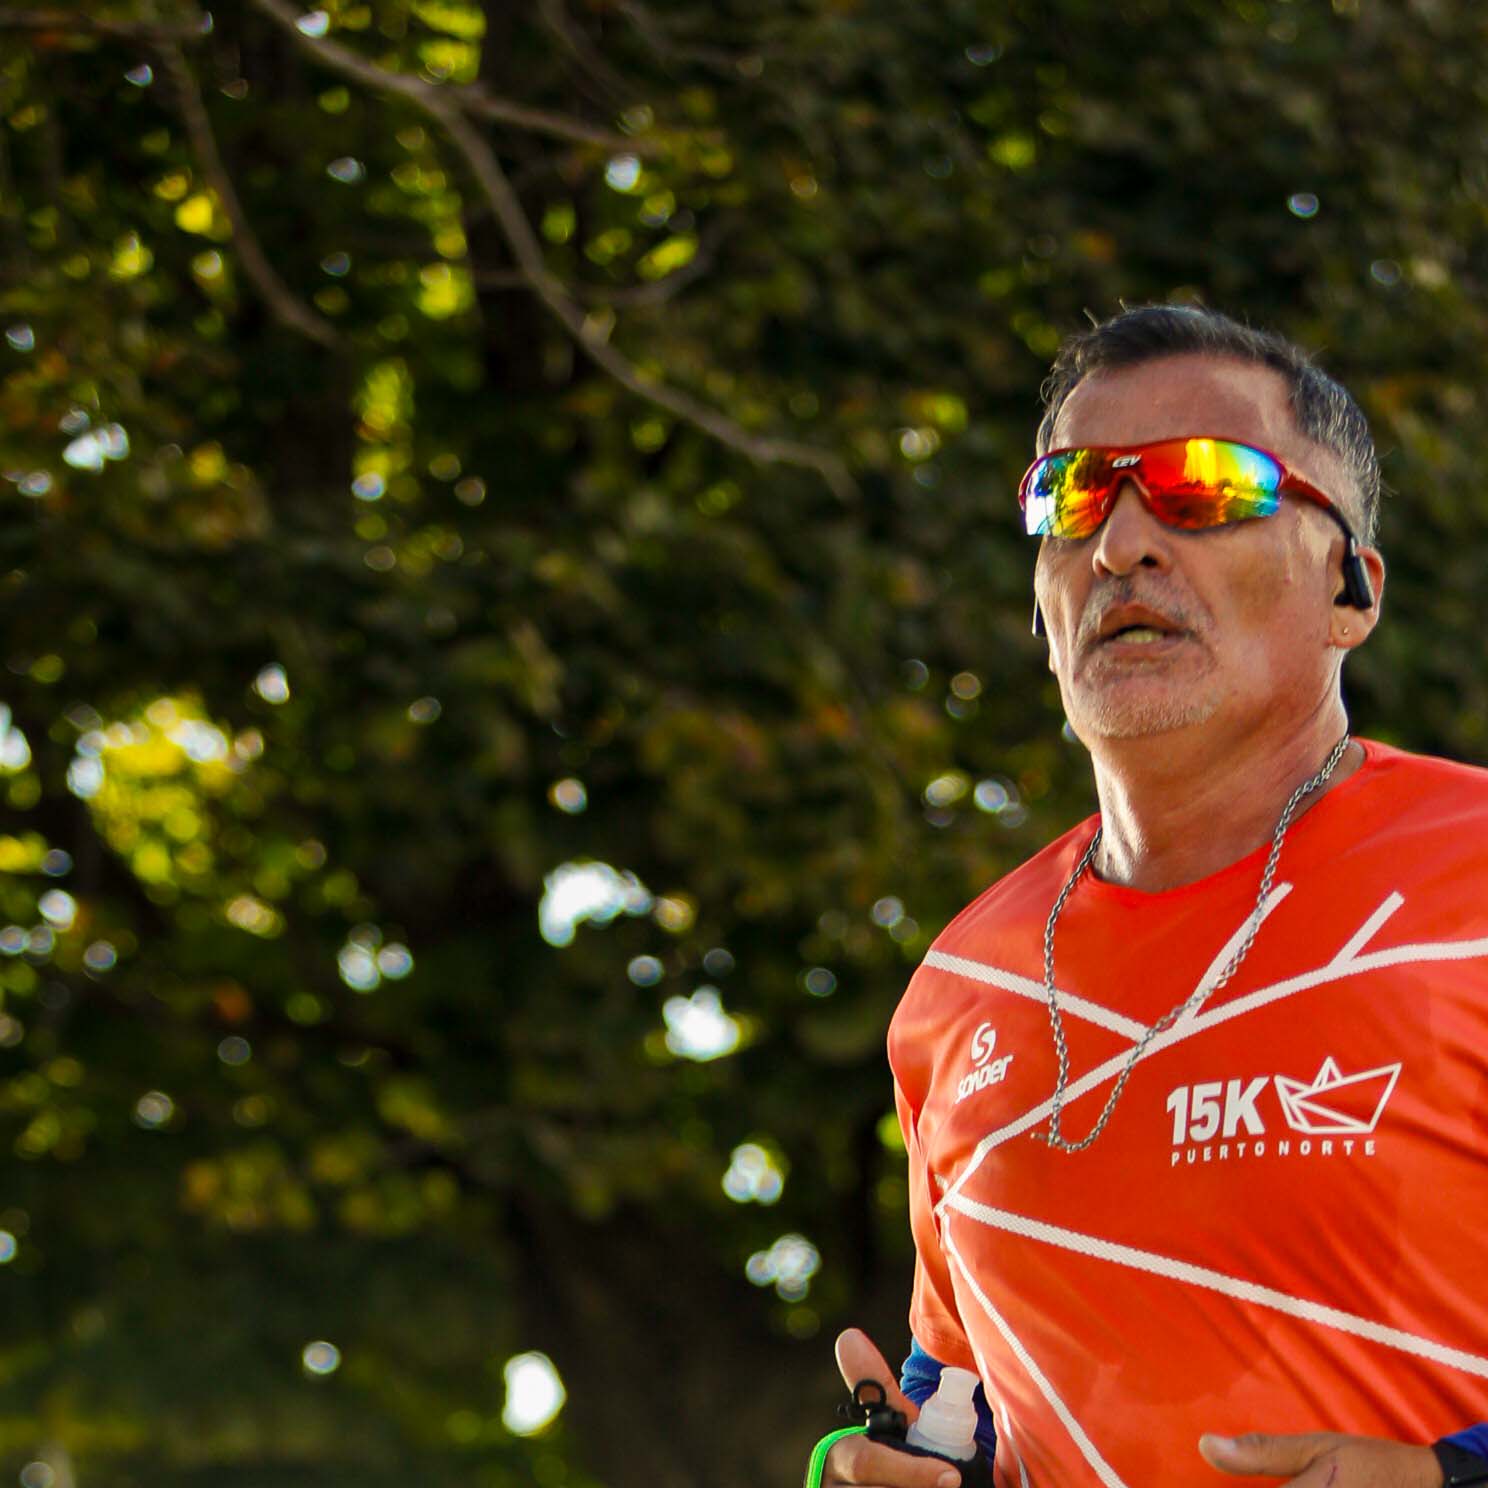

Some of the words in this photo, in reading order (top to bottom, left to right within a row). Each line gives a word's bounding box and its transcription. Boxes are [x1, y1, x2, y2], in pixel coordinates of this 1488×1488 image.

[1167, 1076, 1269, 1145] 15K
[1171, 1140, 1265, 1167] PUERTO
[1278, 1140, 1376, 1156] NORTE
